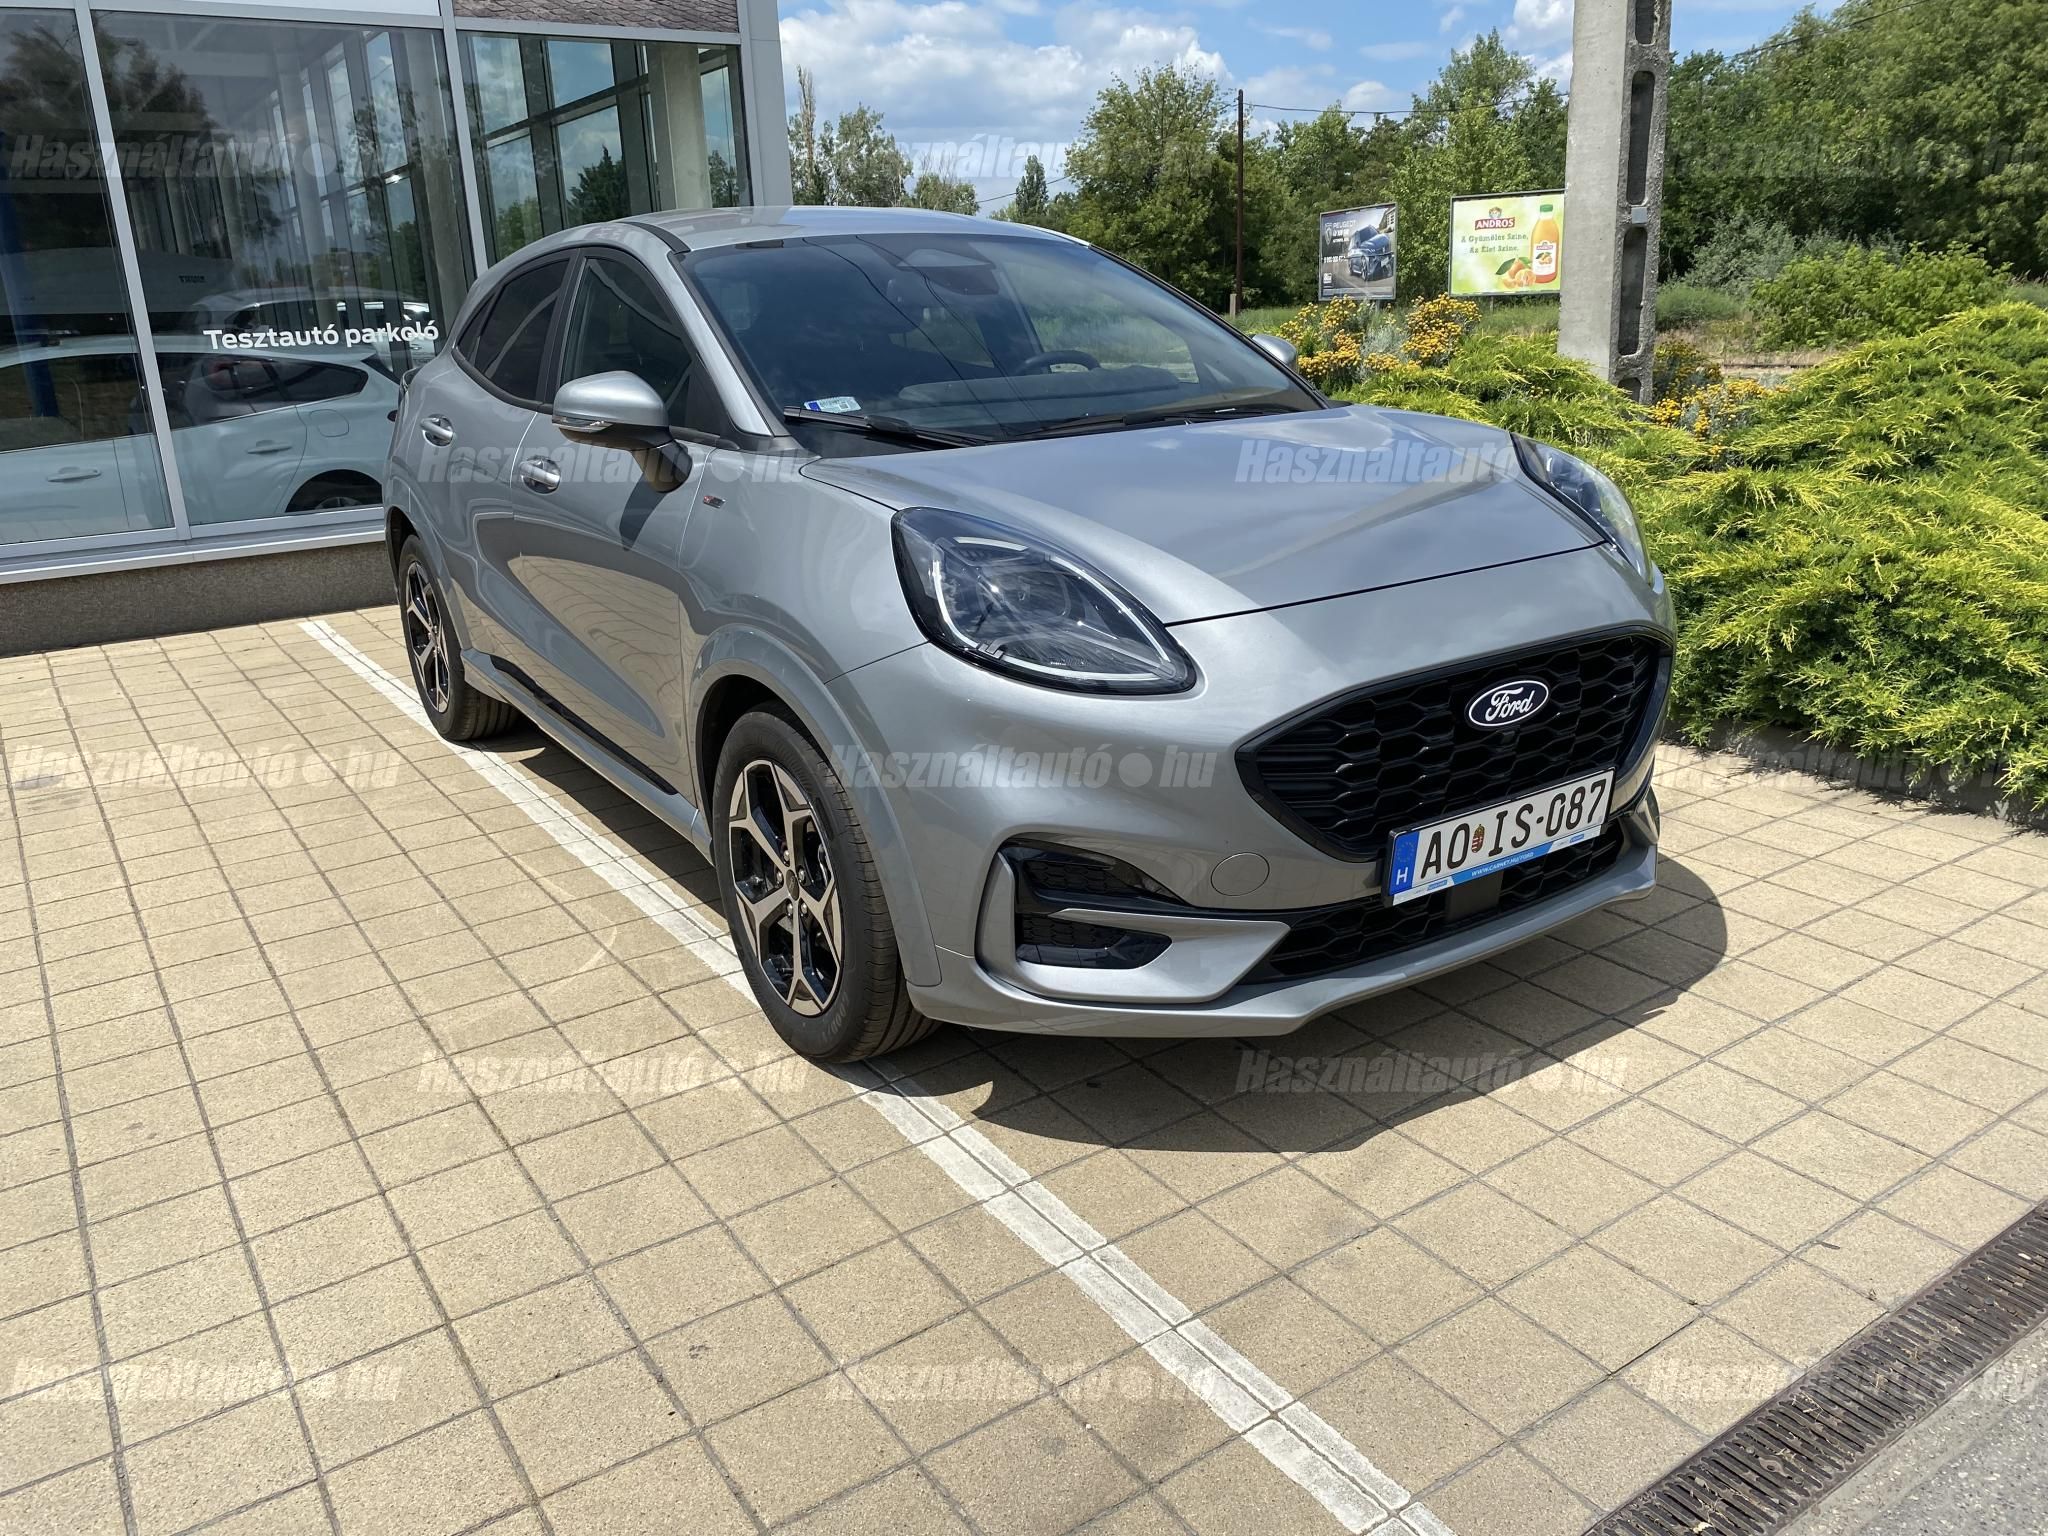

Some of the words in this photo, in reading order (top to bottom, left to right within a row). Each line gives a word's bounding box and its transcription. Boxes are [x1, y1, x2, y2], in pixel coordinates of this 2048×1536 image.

[1476, 218, 1514, 229] ANDROS
[203, 323, 340, 350] Tesztautó
[345, 319, 439, 348] parkoló
[1485, 686, 1537, 722] Ford
[1395, 866, 1409, 886] H
[1420, 822, 1471, 880] AO
